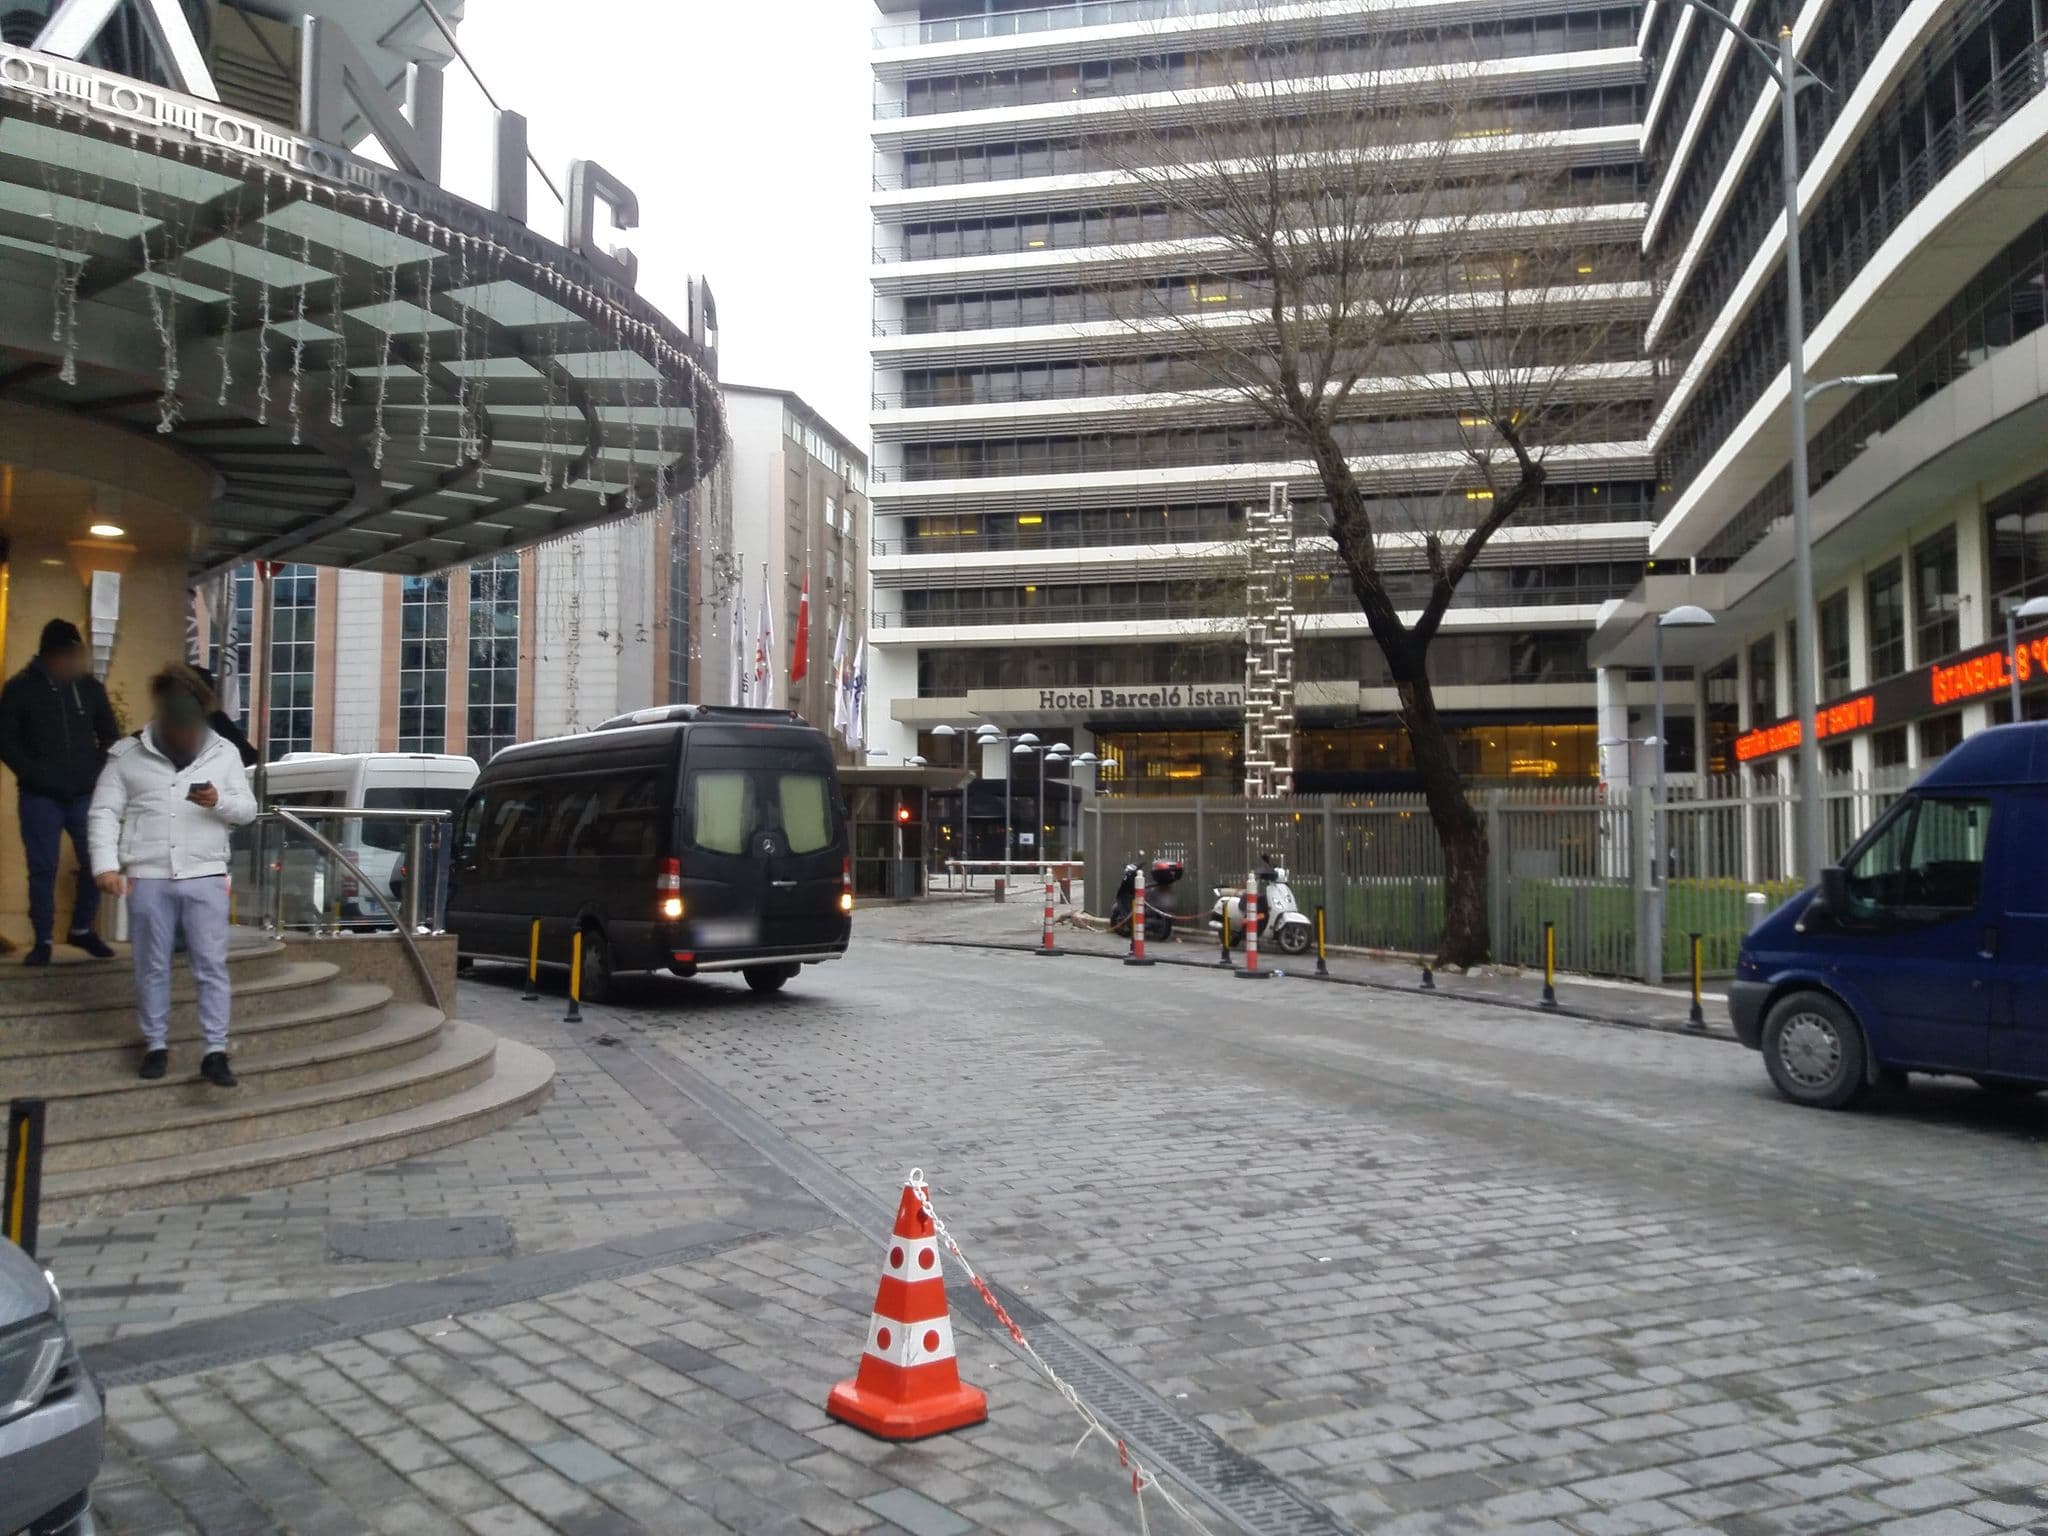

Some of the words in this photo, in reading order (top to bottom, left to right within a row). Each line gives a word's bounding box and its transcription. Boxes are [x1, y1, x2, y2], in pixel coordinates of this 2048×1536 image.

[1039, 690, 1095, 709] Hotel
[1100, 687, 1181, 708] Barceló
[1187, 683, 1246, 706] İstan
